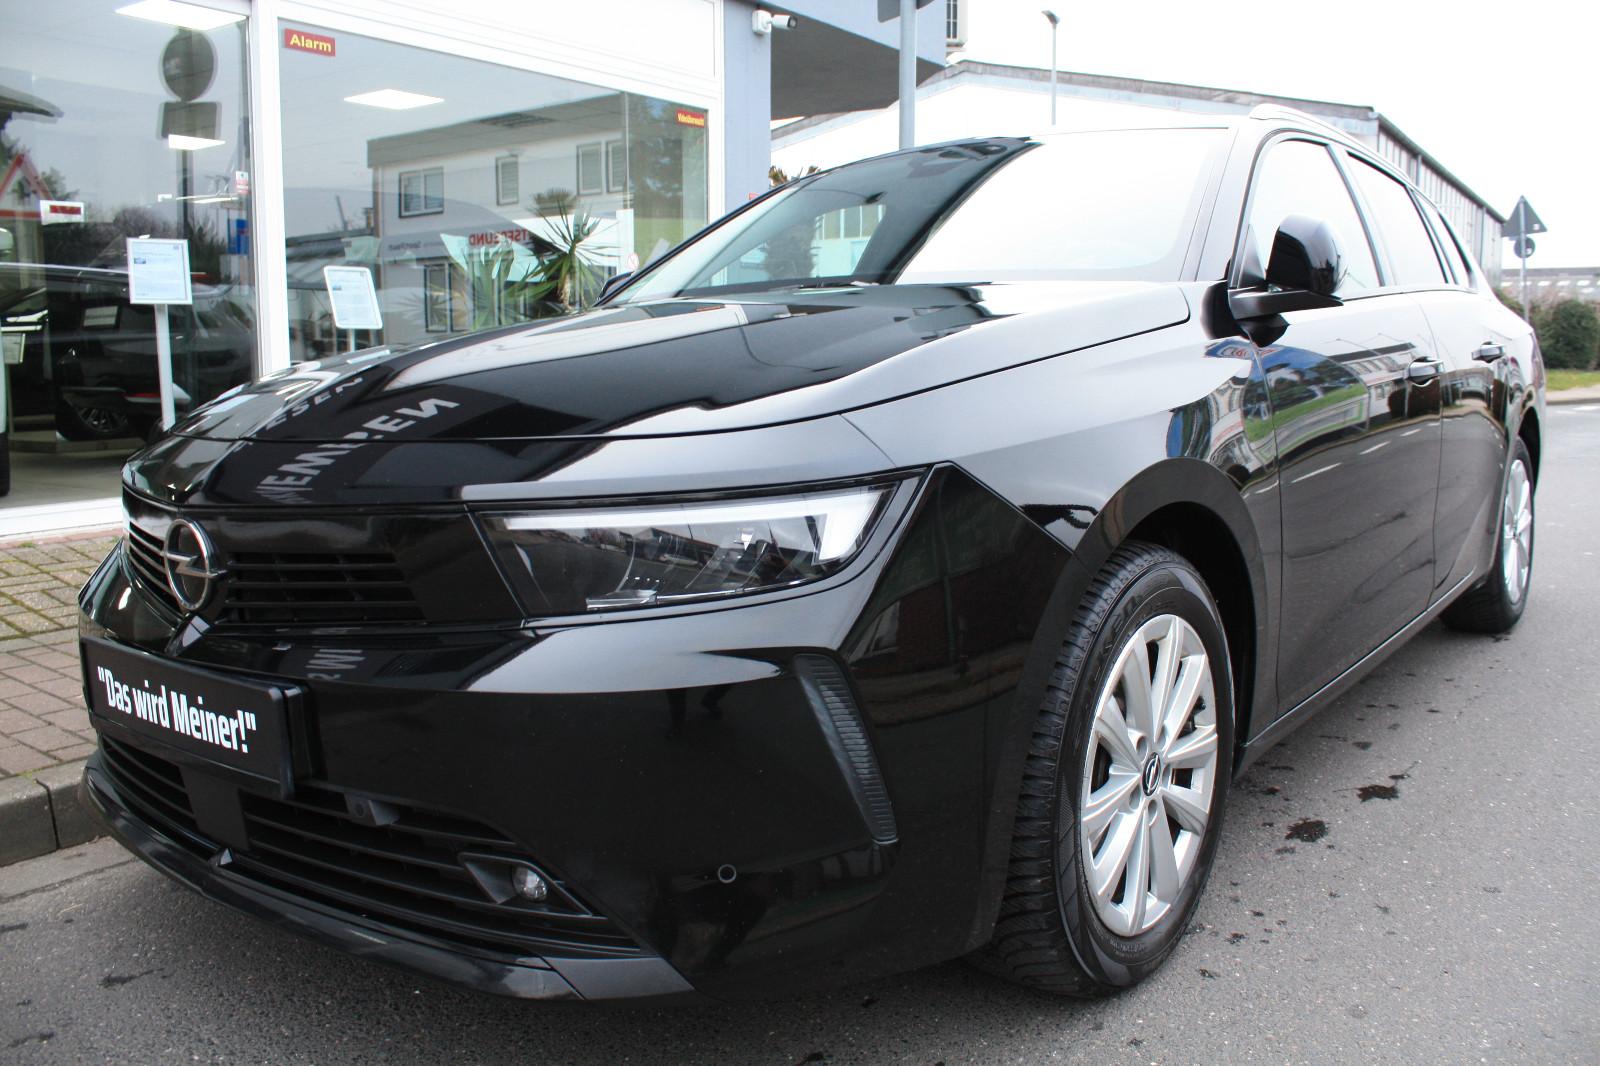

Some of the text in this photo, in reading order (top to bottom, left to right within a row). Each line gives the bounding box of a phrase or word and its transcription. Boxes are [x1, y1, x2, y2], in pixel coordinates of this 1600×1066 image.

[289, 33, 332, 53] Alarm
[97, 666, 257, 754] "Das wird Meiner!"
